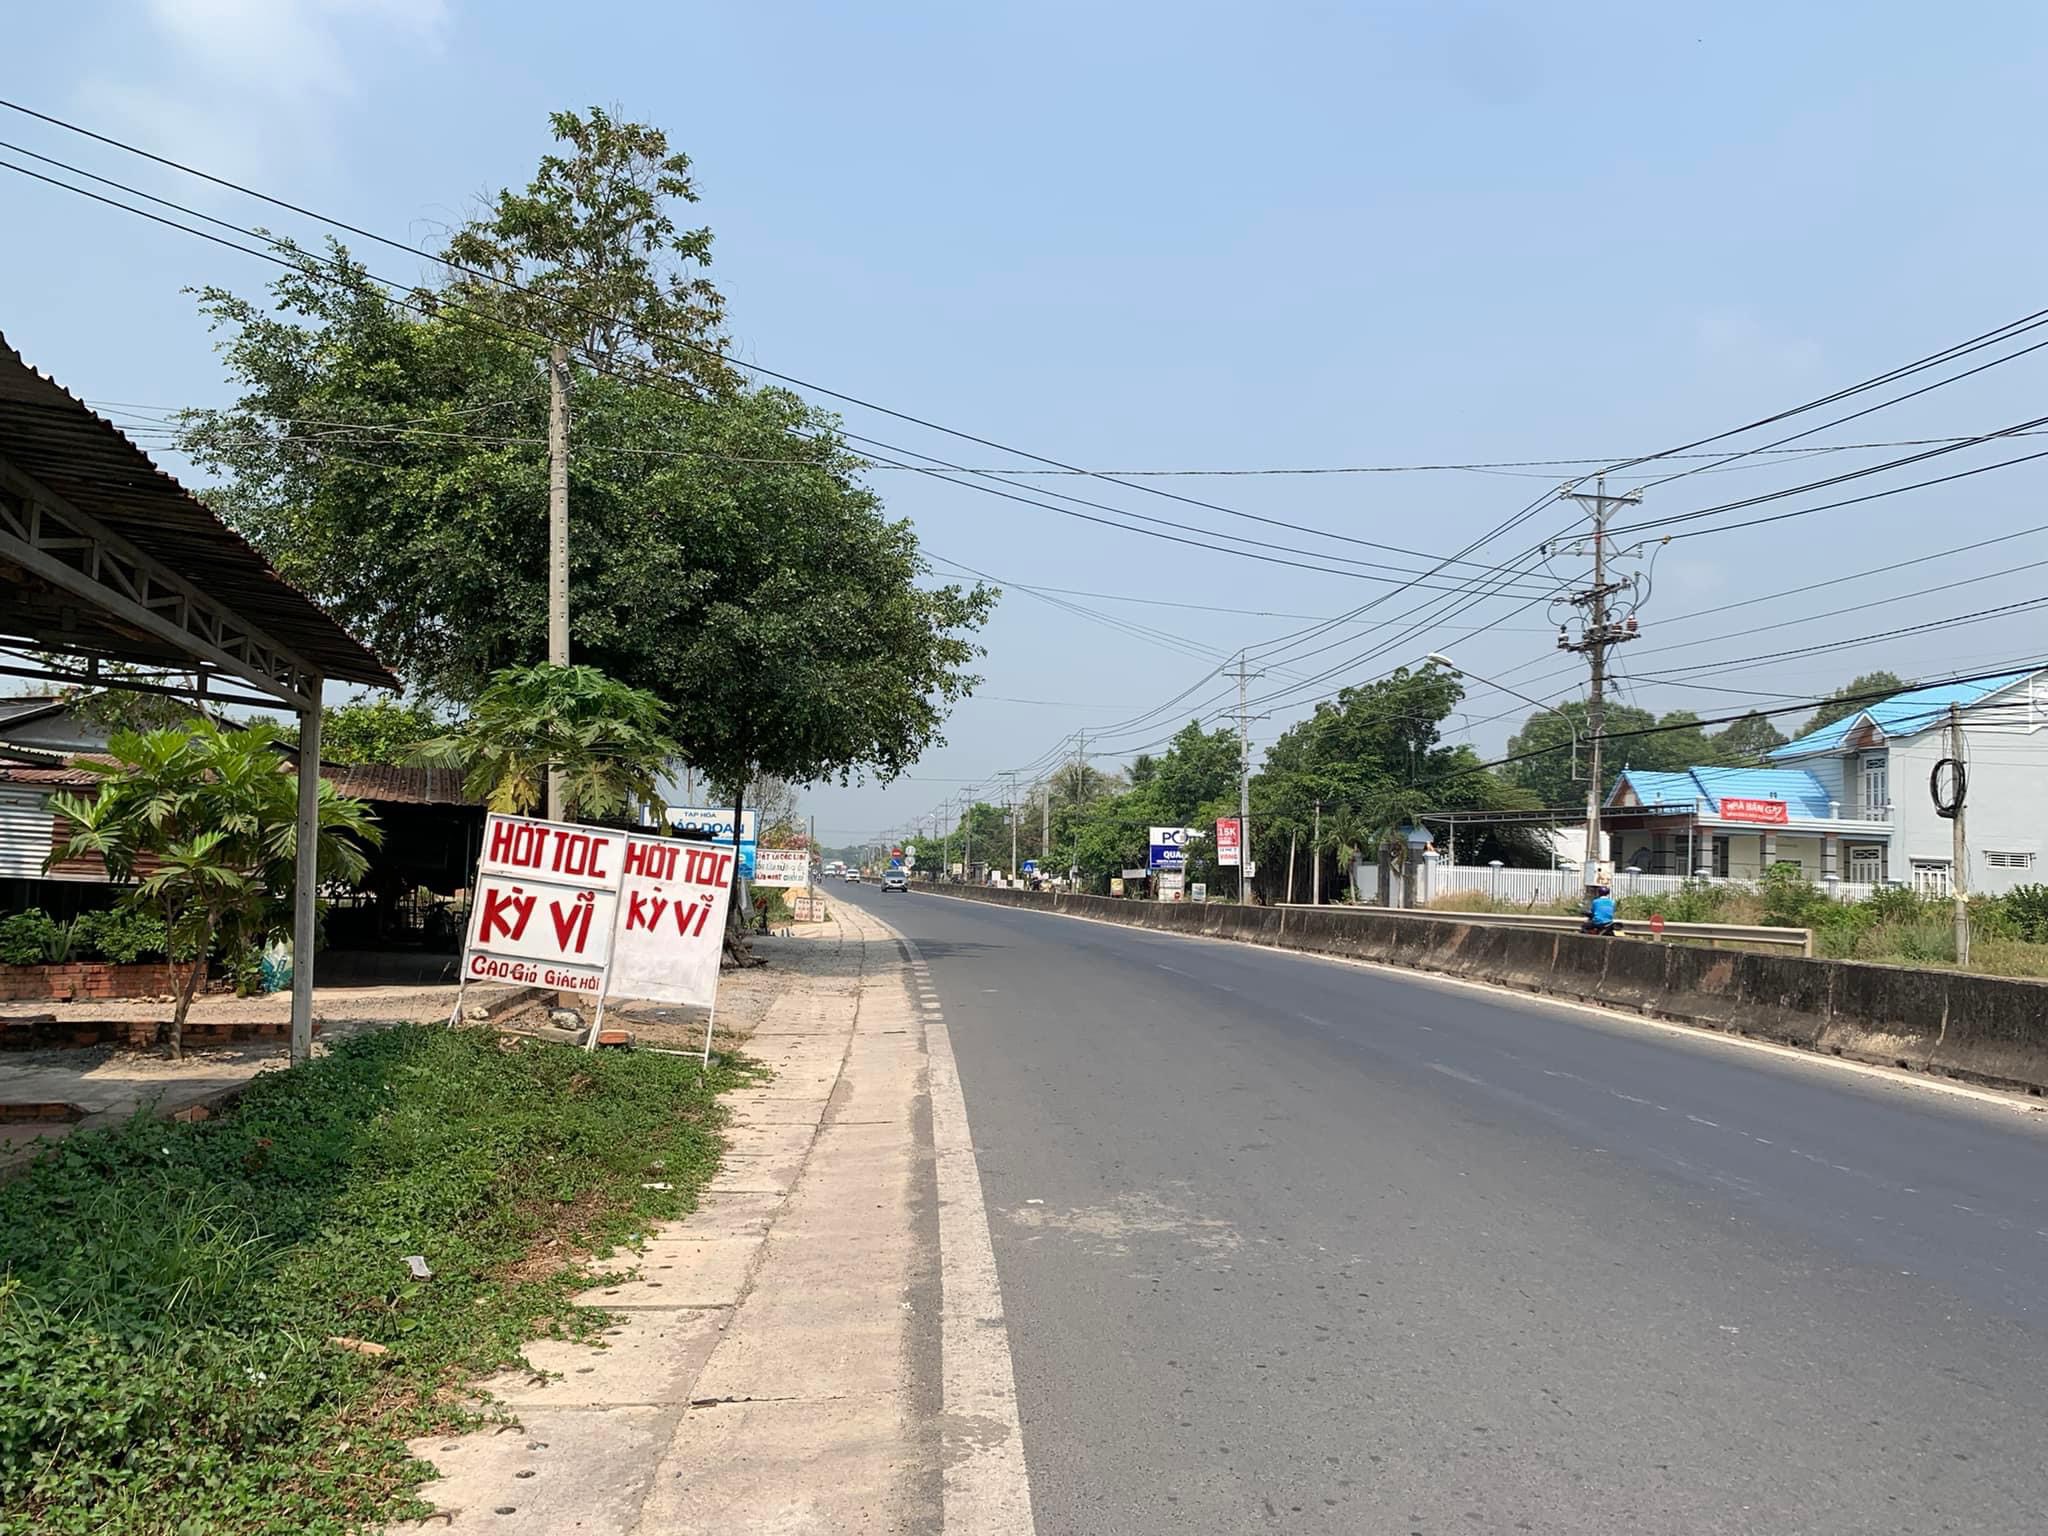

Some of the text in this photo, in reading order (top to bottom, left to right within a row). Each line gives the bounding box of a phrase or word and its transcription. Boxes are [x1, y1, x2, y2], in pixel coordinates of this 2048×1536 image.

[479, 886, 537, 943] KỲ
[626, 886, 668, 933] KỲ
[471, 955, 509, 978] CAO
